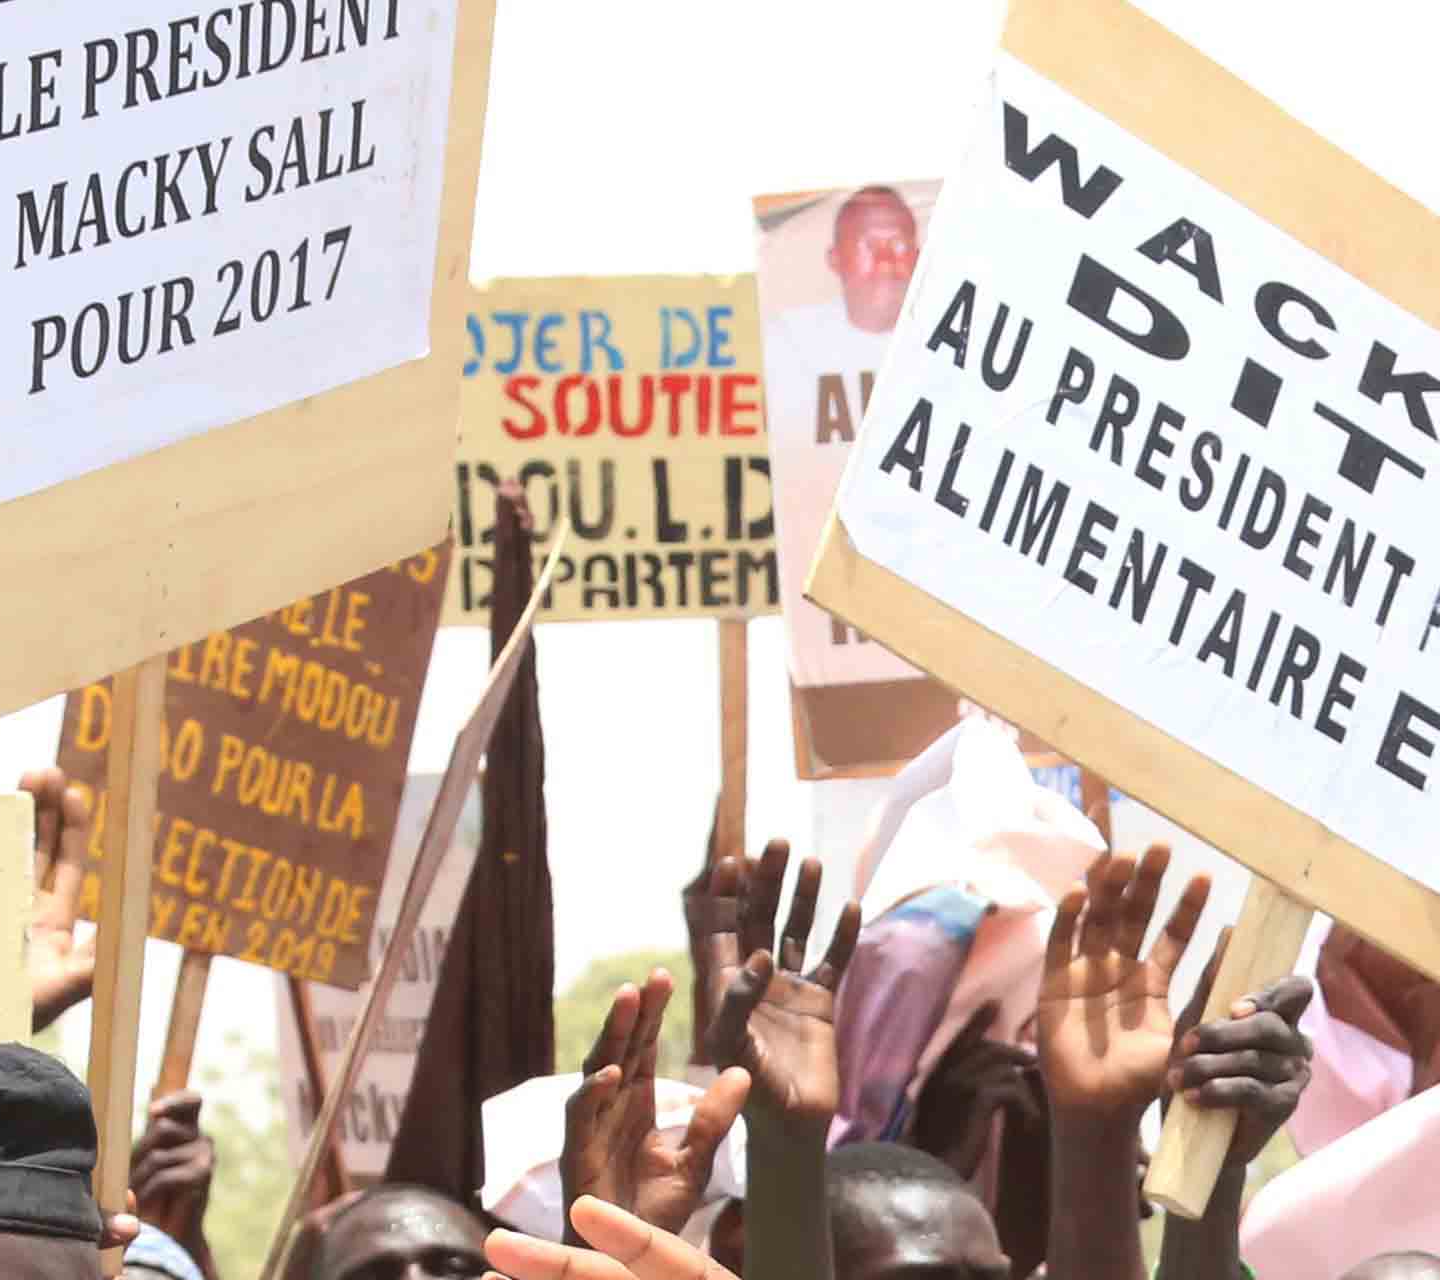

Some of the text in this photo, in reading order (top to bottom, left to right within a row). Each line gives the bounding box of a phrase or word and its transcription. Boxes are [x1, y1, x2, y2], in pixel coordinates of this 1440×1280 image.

[81, 0, 403, 121] PRESIDENT
[13, 99, 377, 270] MACKY SALL
[28, 226, 352, 396] POUR 2017
[660, 307, 736, 369] DE
[1066, 254, 1426, 498] DIT
[926, 280, 1033, 393] AU
[1045, 350, 1416, 630] PRESIDENT
[879, 398, 1368, 744] ALIMENTAIRE
[259, 648, 401, 750] MODOU
[212, 733, 312, 825] POUR
[318, 774, 367, 840] LA
[319, 870, 375, 943] DE
